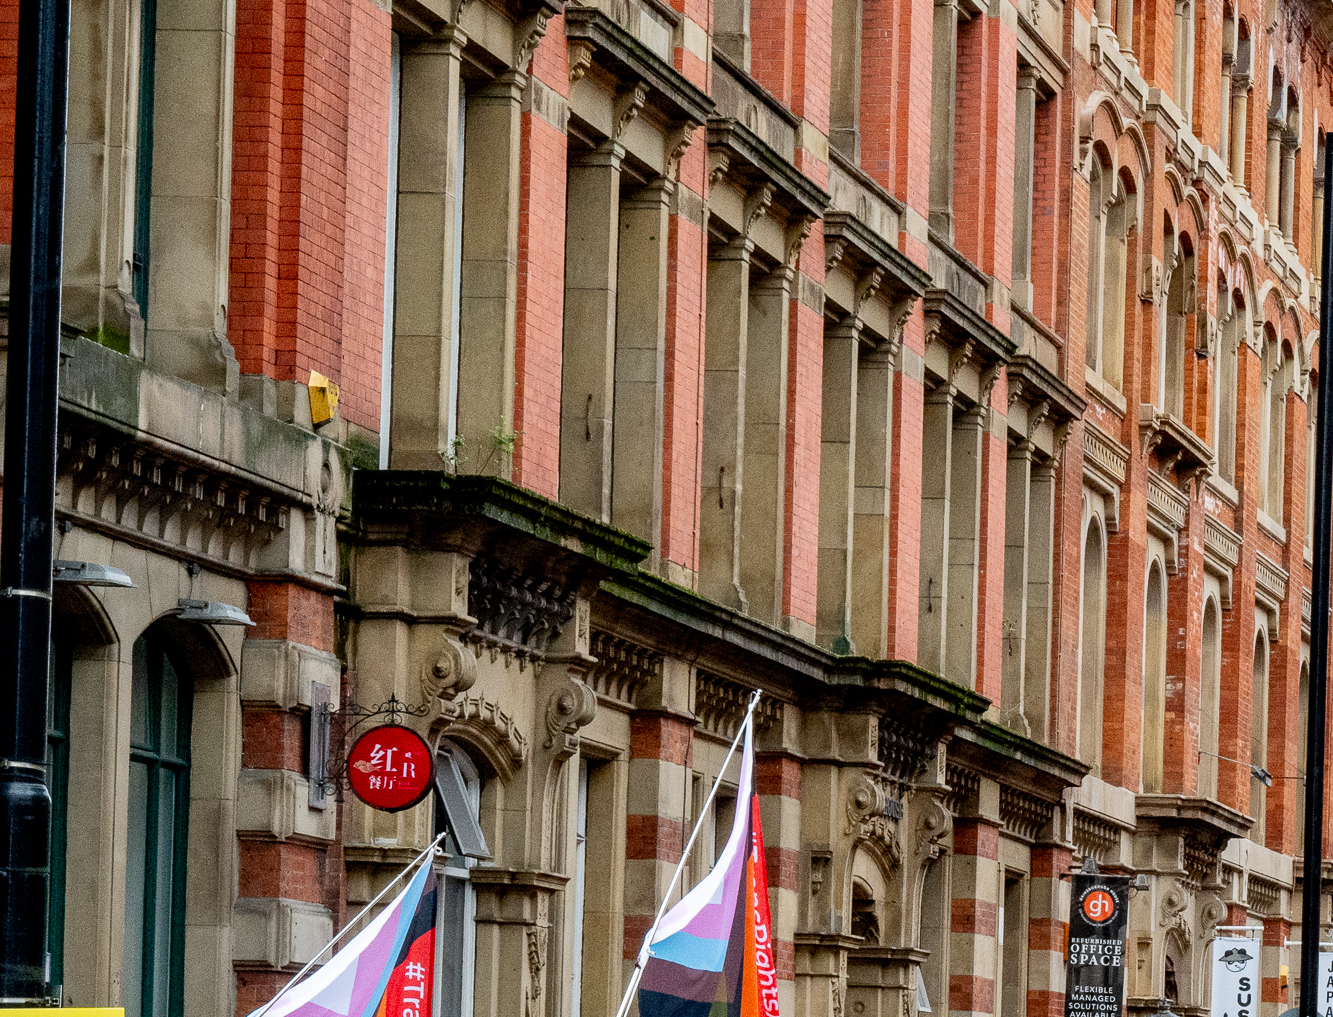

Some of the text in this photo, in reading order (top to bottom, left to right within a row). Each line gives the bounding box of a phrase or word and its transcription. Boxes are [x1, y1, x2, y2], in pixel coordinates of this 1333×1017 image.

[370, 744, 398, 772] 红
[1089, 893, 1109, 918] gh
[1071, 937, 1122, 946] REFURBISHED
[1070, 943, 1122, 956] OFFICE
[1070, 953, 1121, 967] SPACE
[1074, 985, 1113, 994] FLEXIBLE
[1071, 994, 1116, 1003] MANAGED
[1068, 1002, 1118, 1012] SOLUTIONS
